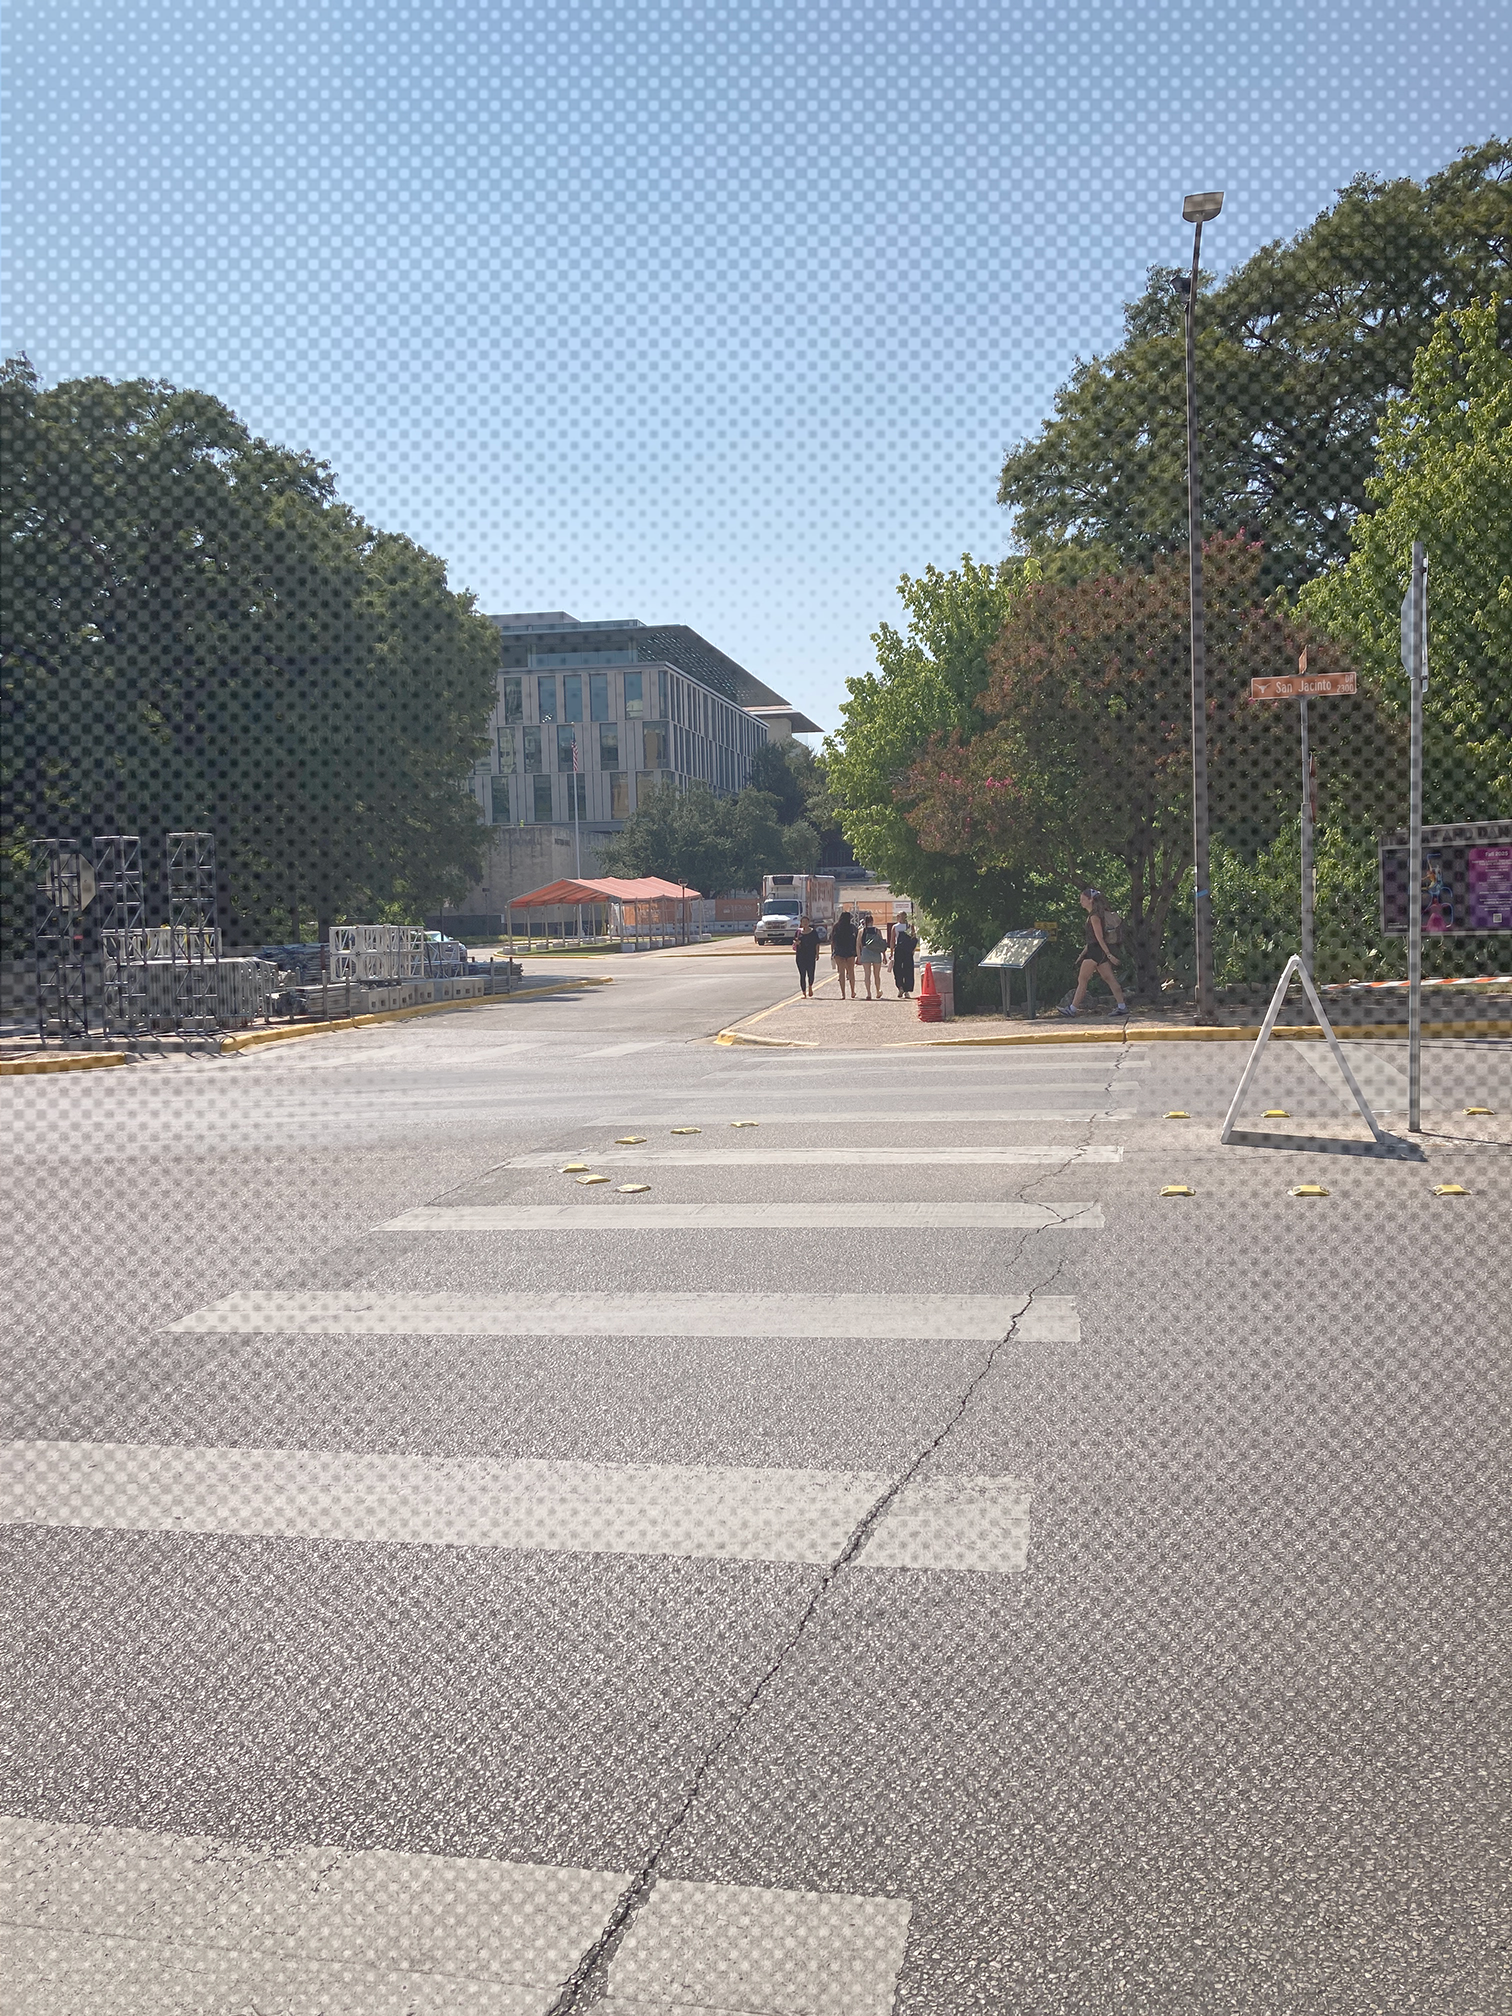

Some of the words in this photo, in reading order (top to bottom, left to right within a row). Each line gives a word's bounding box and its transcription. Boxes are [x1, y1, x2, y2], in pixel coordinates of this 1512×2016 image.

[1345, 675, 1354, 683] DR
[1276, 682, 1293, 694] San
[1298, 680, 1332, 692] Jacinto
[1336, 684, 1354, 693] 2300
[1442, 827, 1474, 842] AND
